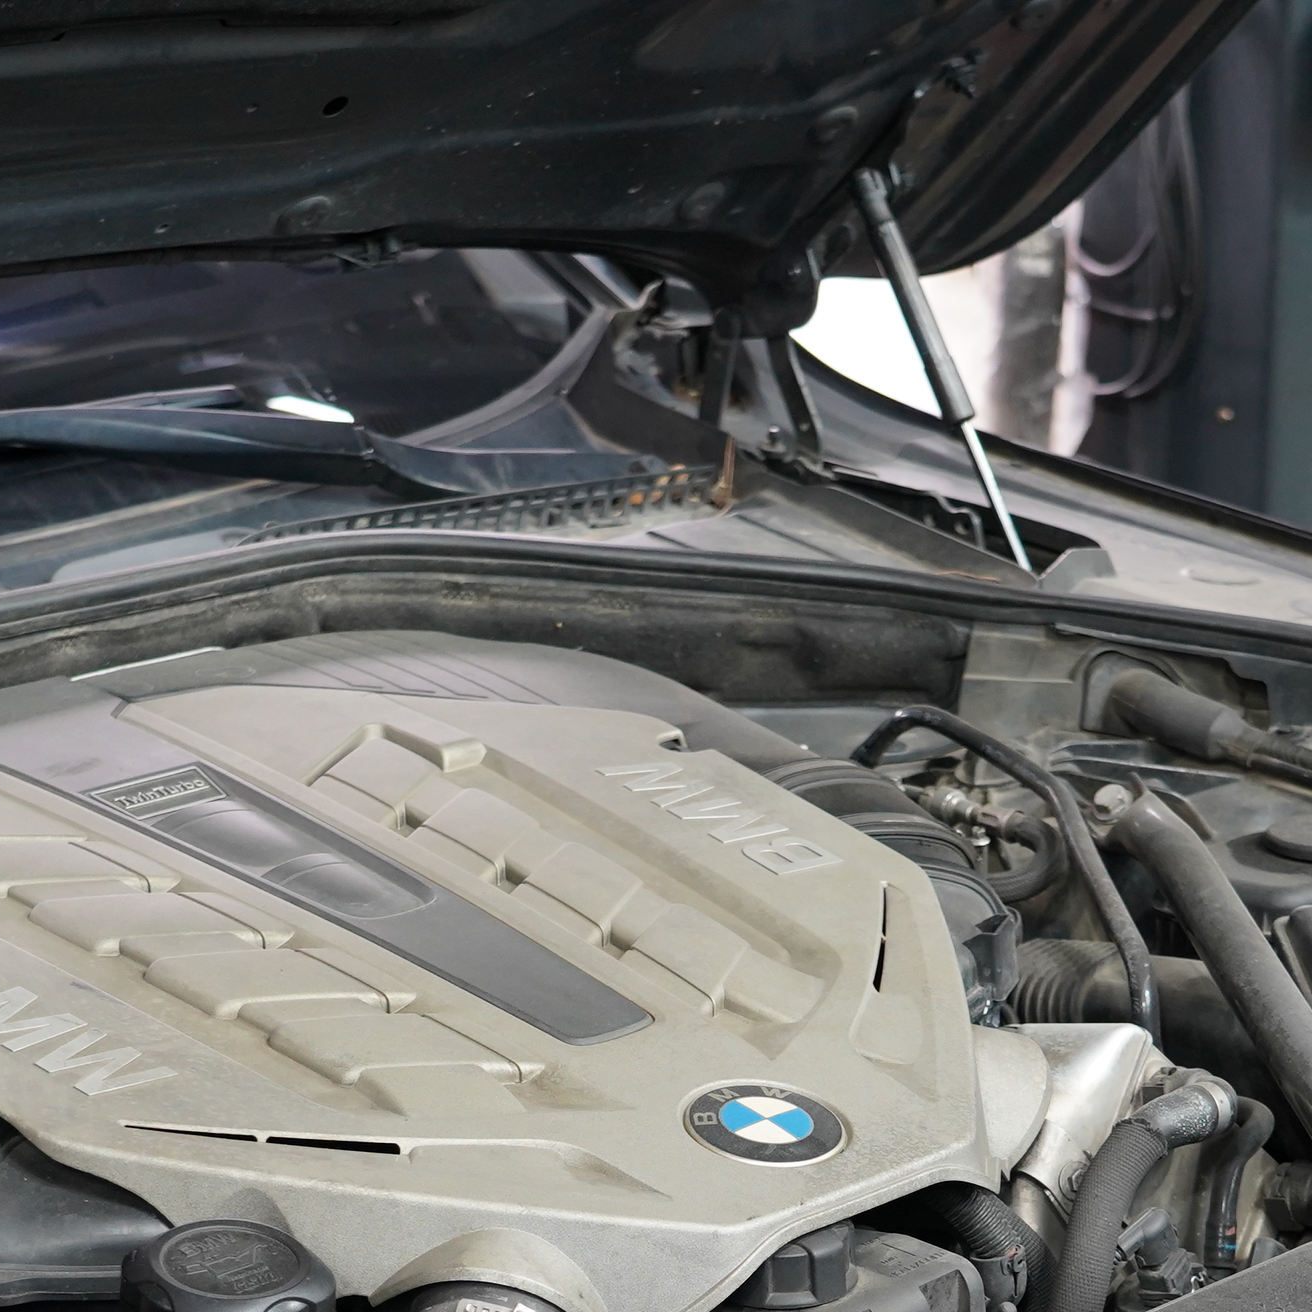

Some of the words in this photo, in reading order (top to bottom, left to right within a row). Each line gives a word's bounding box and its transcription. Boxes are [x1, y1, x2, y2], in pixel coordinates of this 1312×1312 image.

[114, 779, 206, 806] TwinTurbo
[596, 761, 843, 876] BMW
[693, 1086, 794, 1126] BMW
[177, 1231, 238, 1258] BMW
